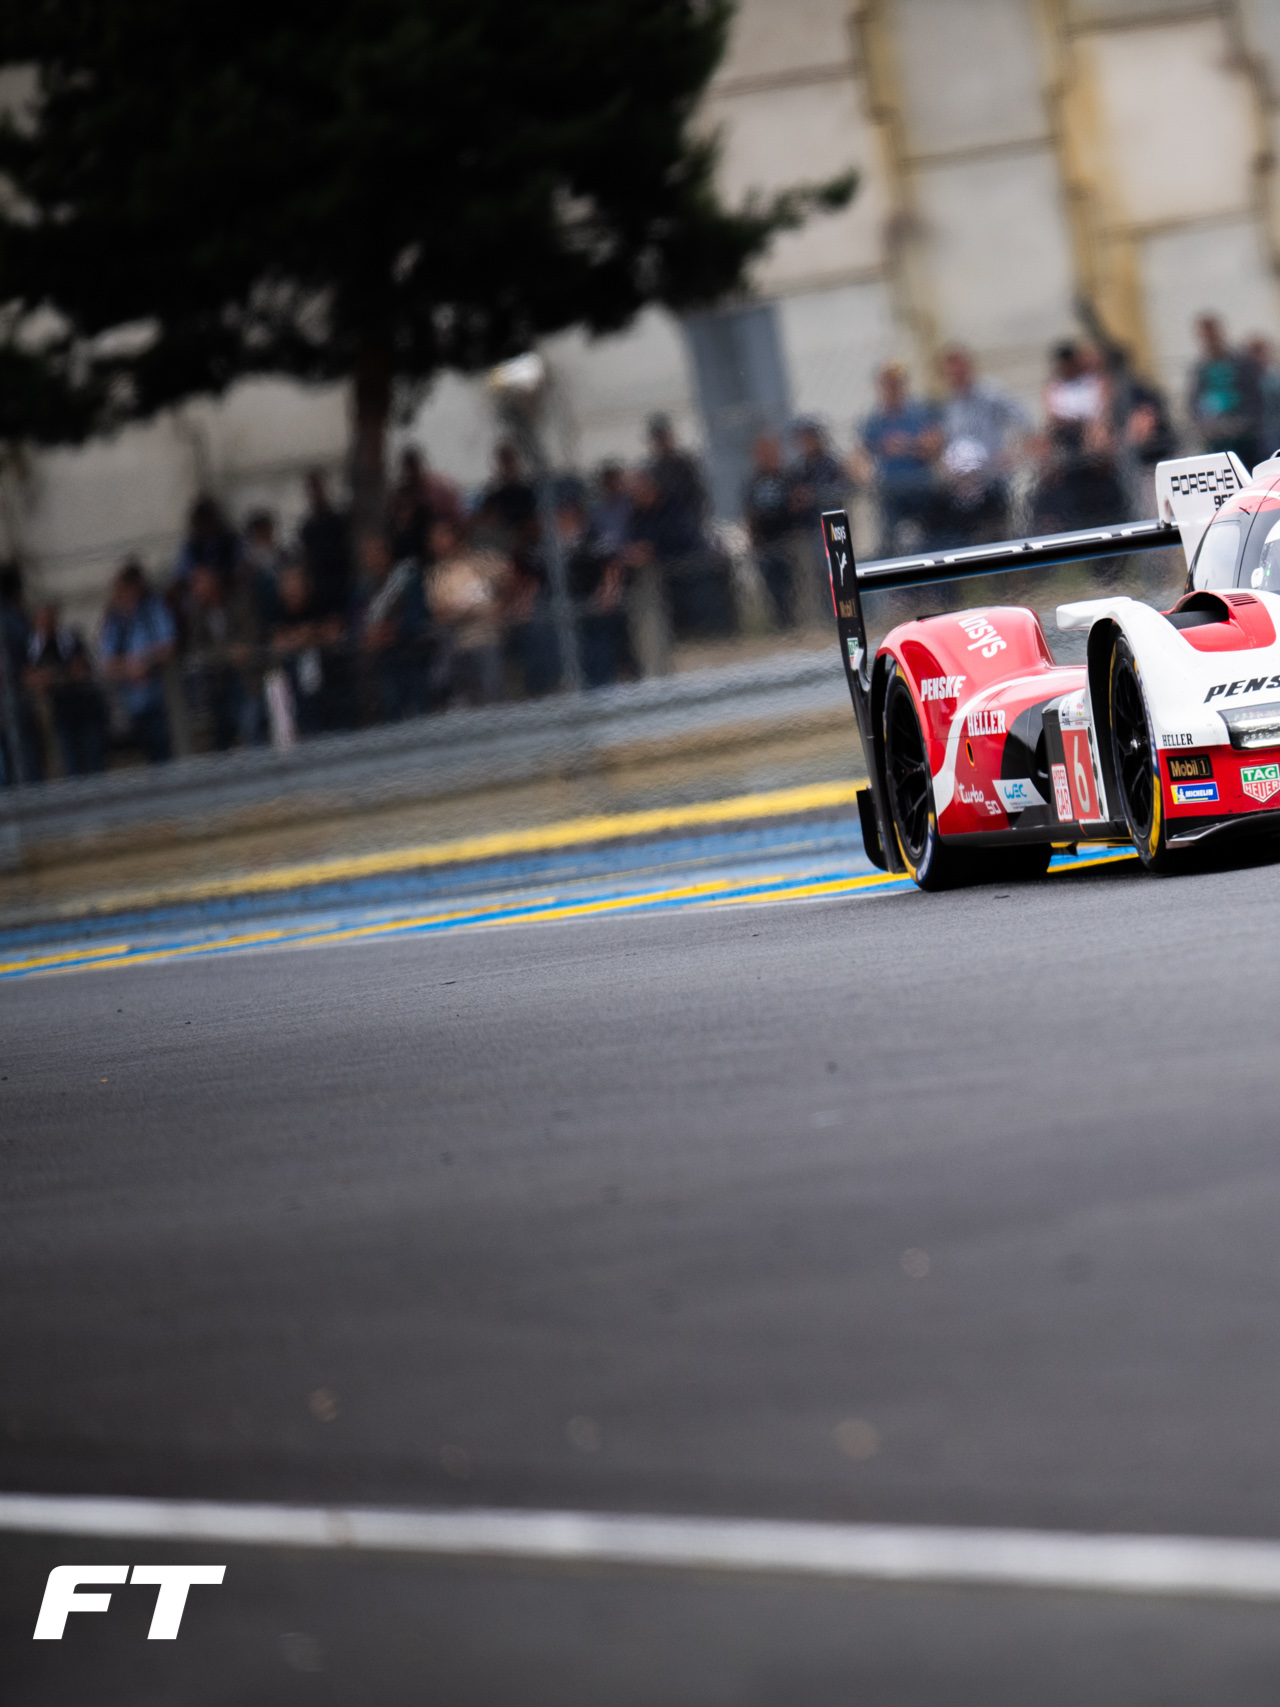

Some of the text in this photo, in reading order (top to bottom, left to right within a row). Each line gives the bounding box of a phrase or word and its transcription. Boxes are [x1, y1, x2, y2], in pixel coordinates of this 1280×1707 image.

[1171, 469, 1234, 497] PORSCHE
[921, 676, 967, 702] PENSKE
[967, 709, 1006, 737] HELLER
[1162, 733, 1193, 747] HELLER
[1073, 735, 1091, 813] 6
[1170, 759, 1198, 777] Mobil
[1244, 766, 1277, 781] TAG
[1004, 783, 1027, 799] WEC
[1185, 788, 1213, 798] MICHELIN
[1244, 780, 1280, 800] HEUER
[1056, 787, 1072, 816] CAR
